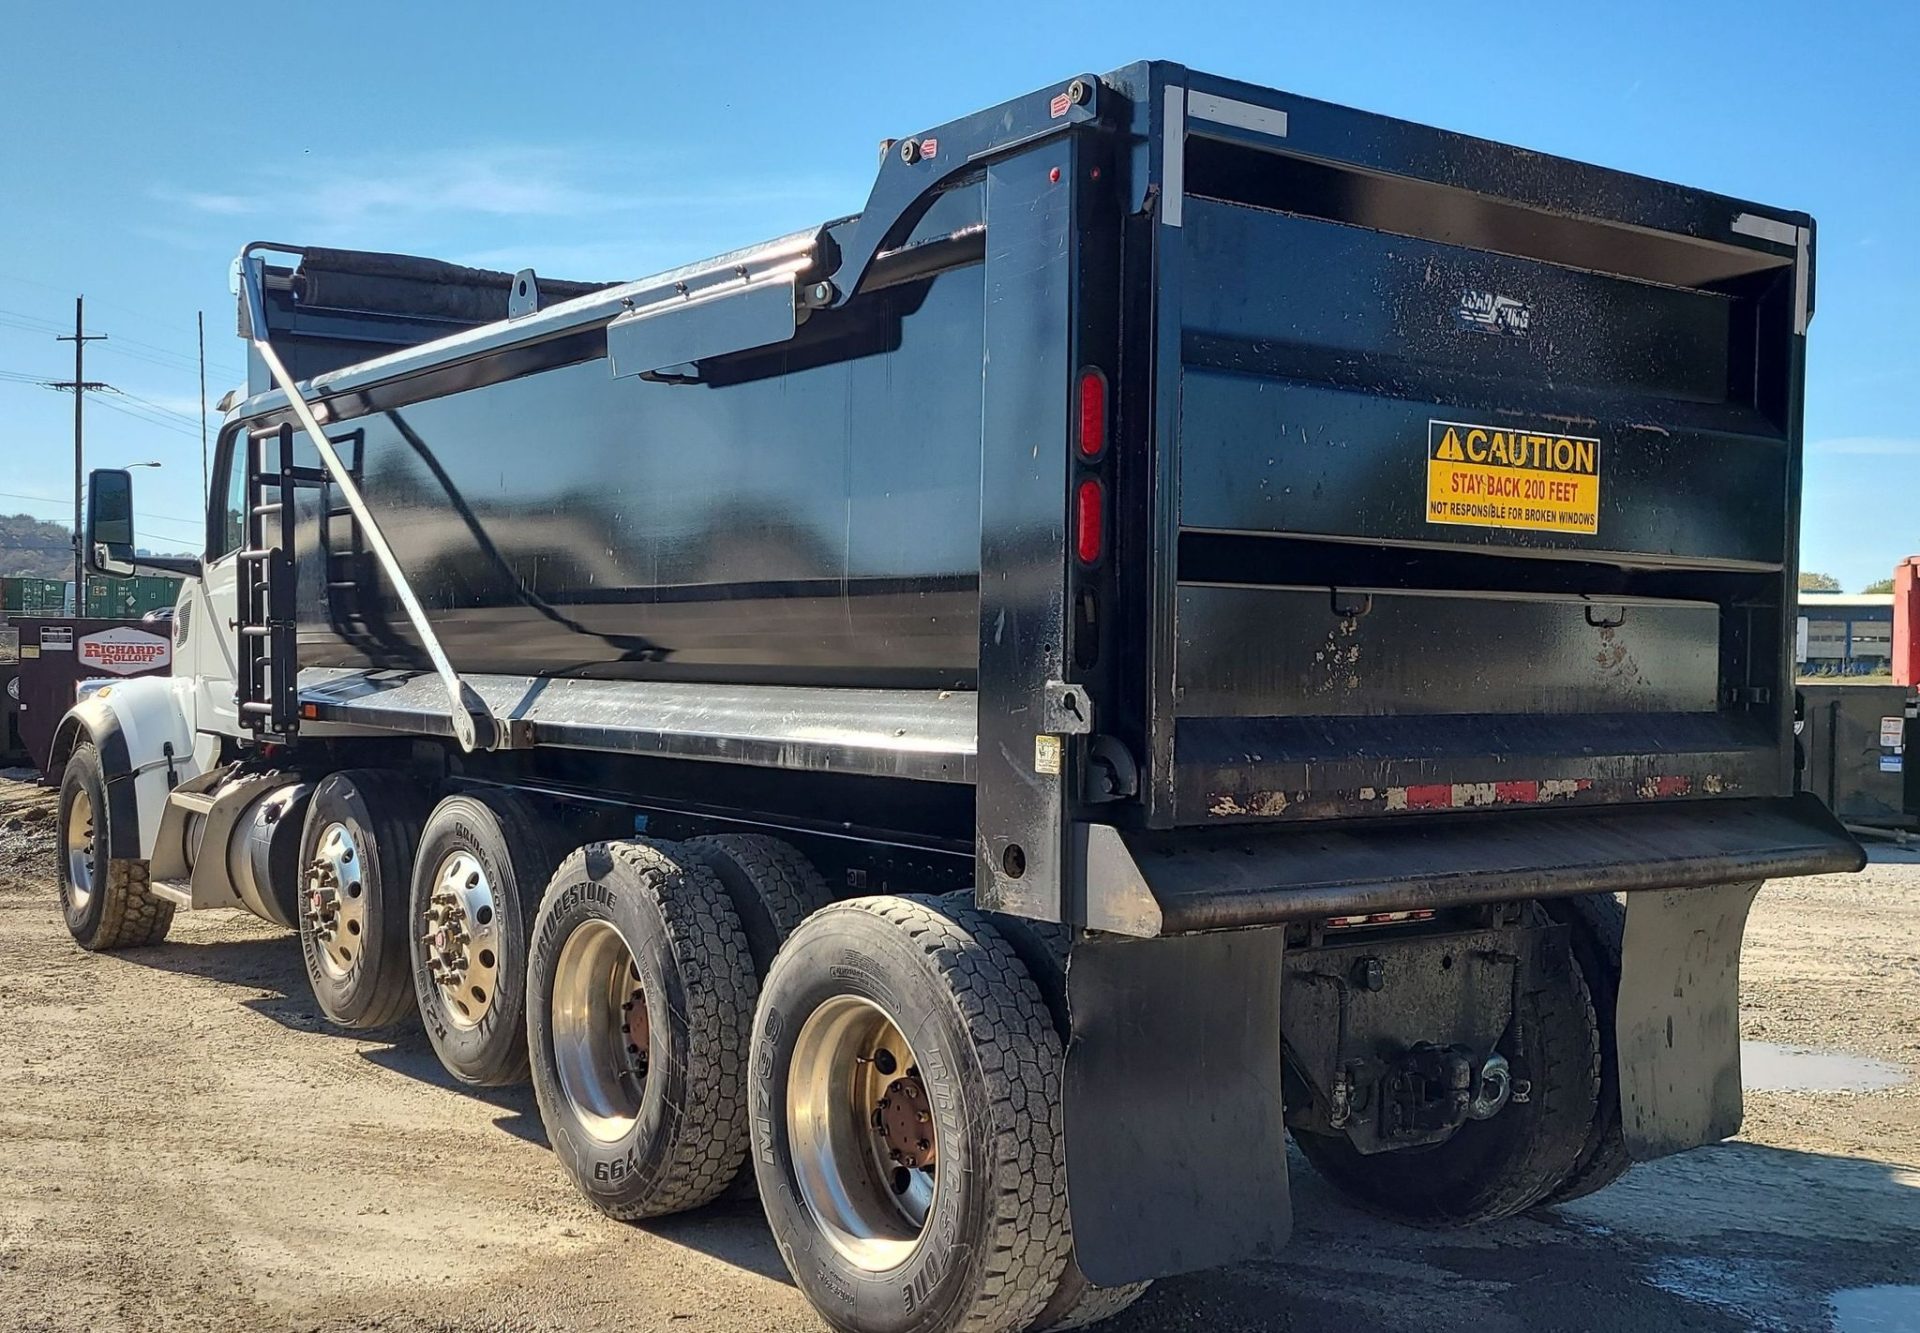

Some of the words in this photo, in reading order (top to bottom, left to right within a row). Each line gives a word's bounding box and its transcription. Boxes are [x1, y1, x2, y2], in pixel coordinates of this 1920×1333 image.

[1466, 429, 1594, 472] CAUTION
[1451, 472, 1483, 495] STAY
[1487, 476, 1521, 498] BACK
[1525, 479, 1546, 500] 200
[1550, 481, 1578, 503] FEET
[1430, 501, 1448, 516] NOT
[1450, 503, 1505, 519] RESPONSIBLE
[1508, 507, 1523, 520] FOR
[1525, 508, 1557, 523] BROKEN
[1559, 511, 1595, 526] WINDOWS
[84, 643, 165, 657] RICHARDS
[101, 655, 155, 665] ROLLOFF
